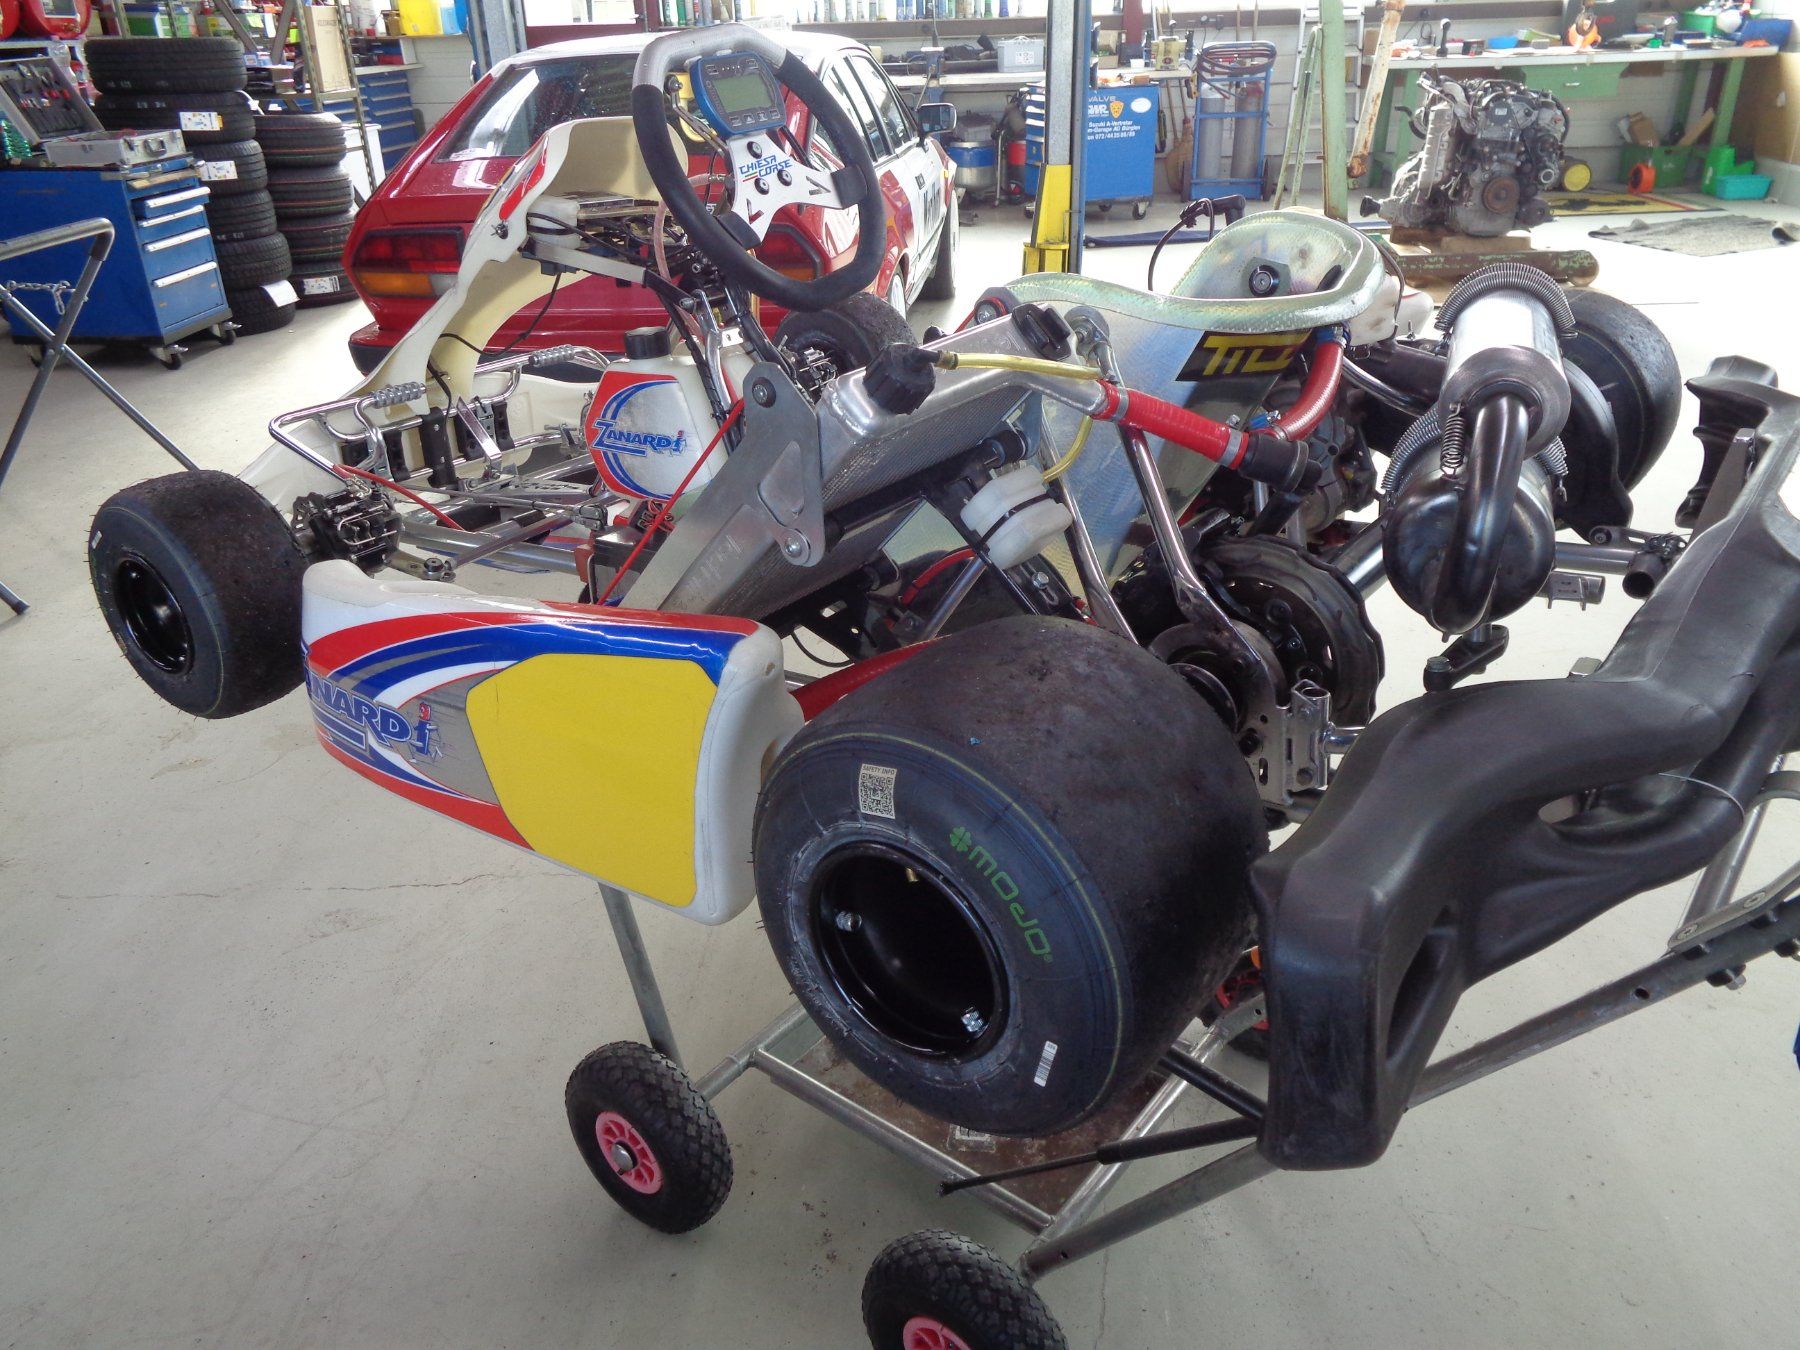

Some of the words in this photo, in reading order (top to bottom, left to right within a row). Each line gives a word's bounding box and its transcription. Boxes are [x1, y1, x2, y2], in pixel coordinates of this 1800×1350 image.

[738, 155, 777, 175] CHIESA
[758, 159, 794, 178] CORSE
[862, 764, 882, 773] SAFETY
